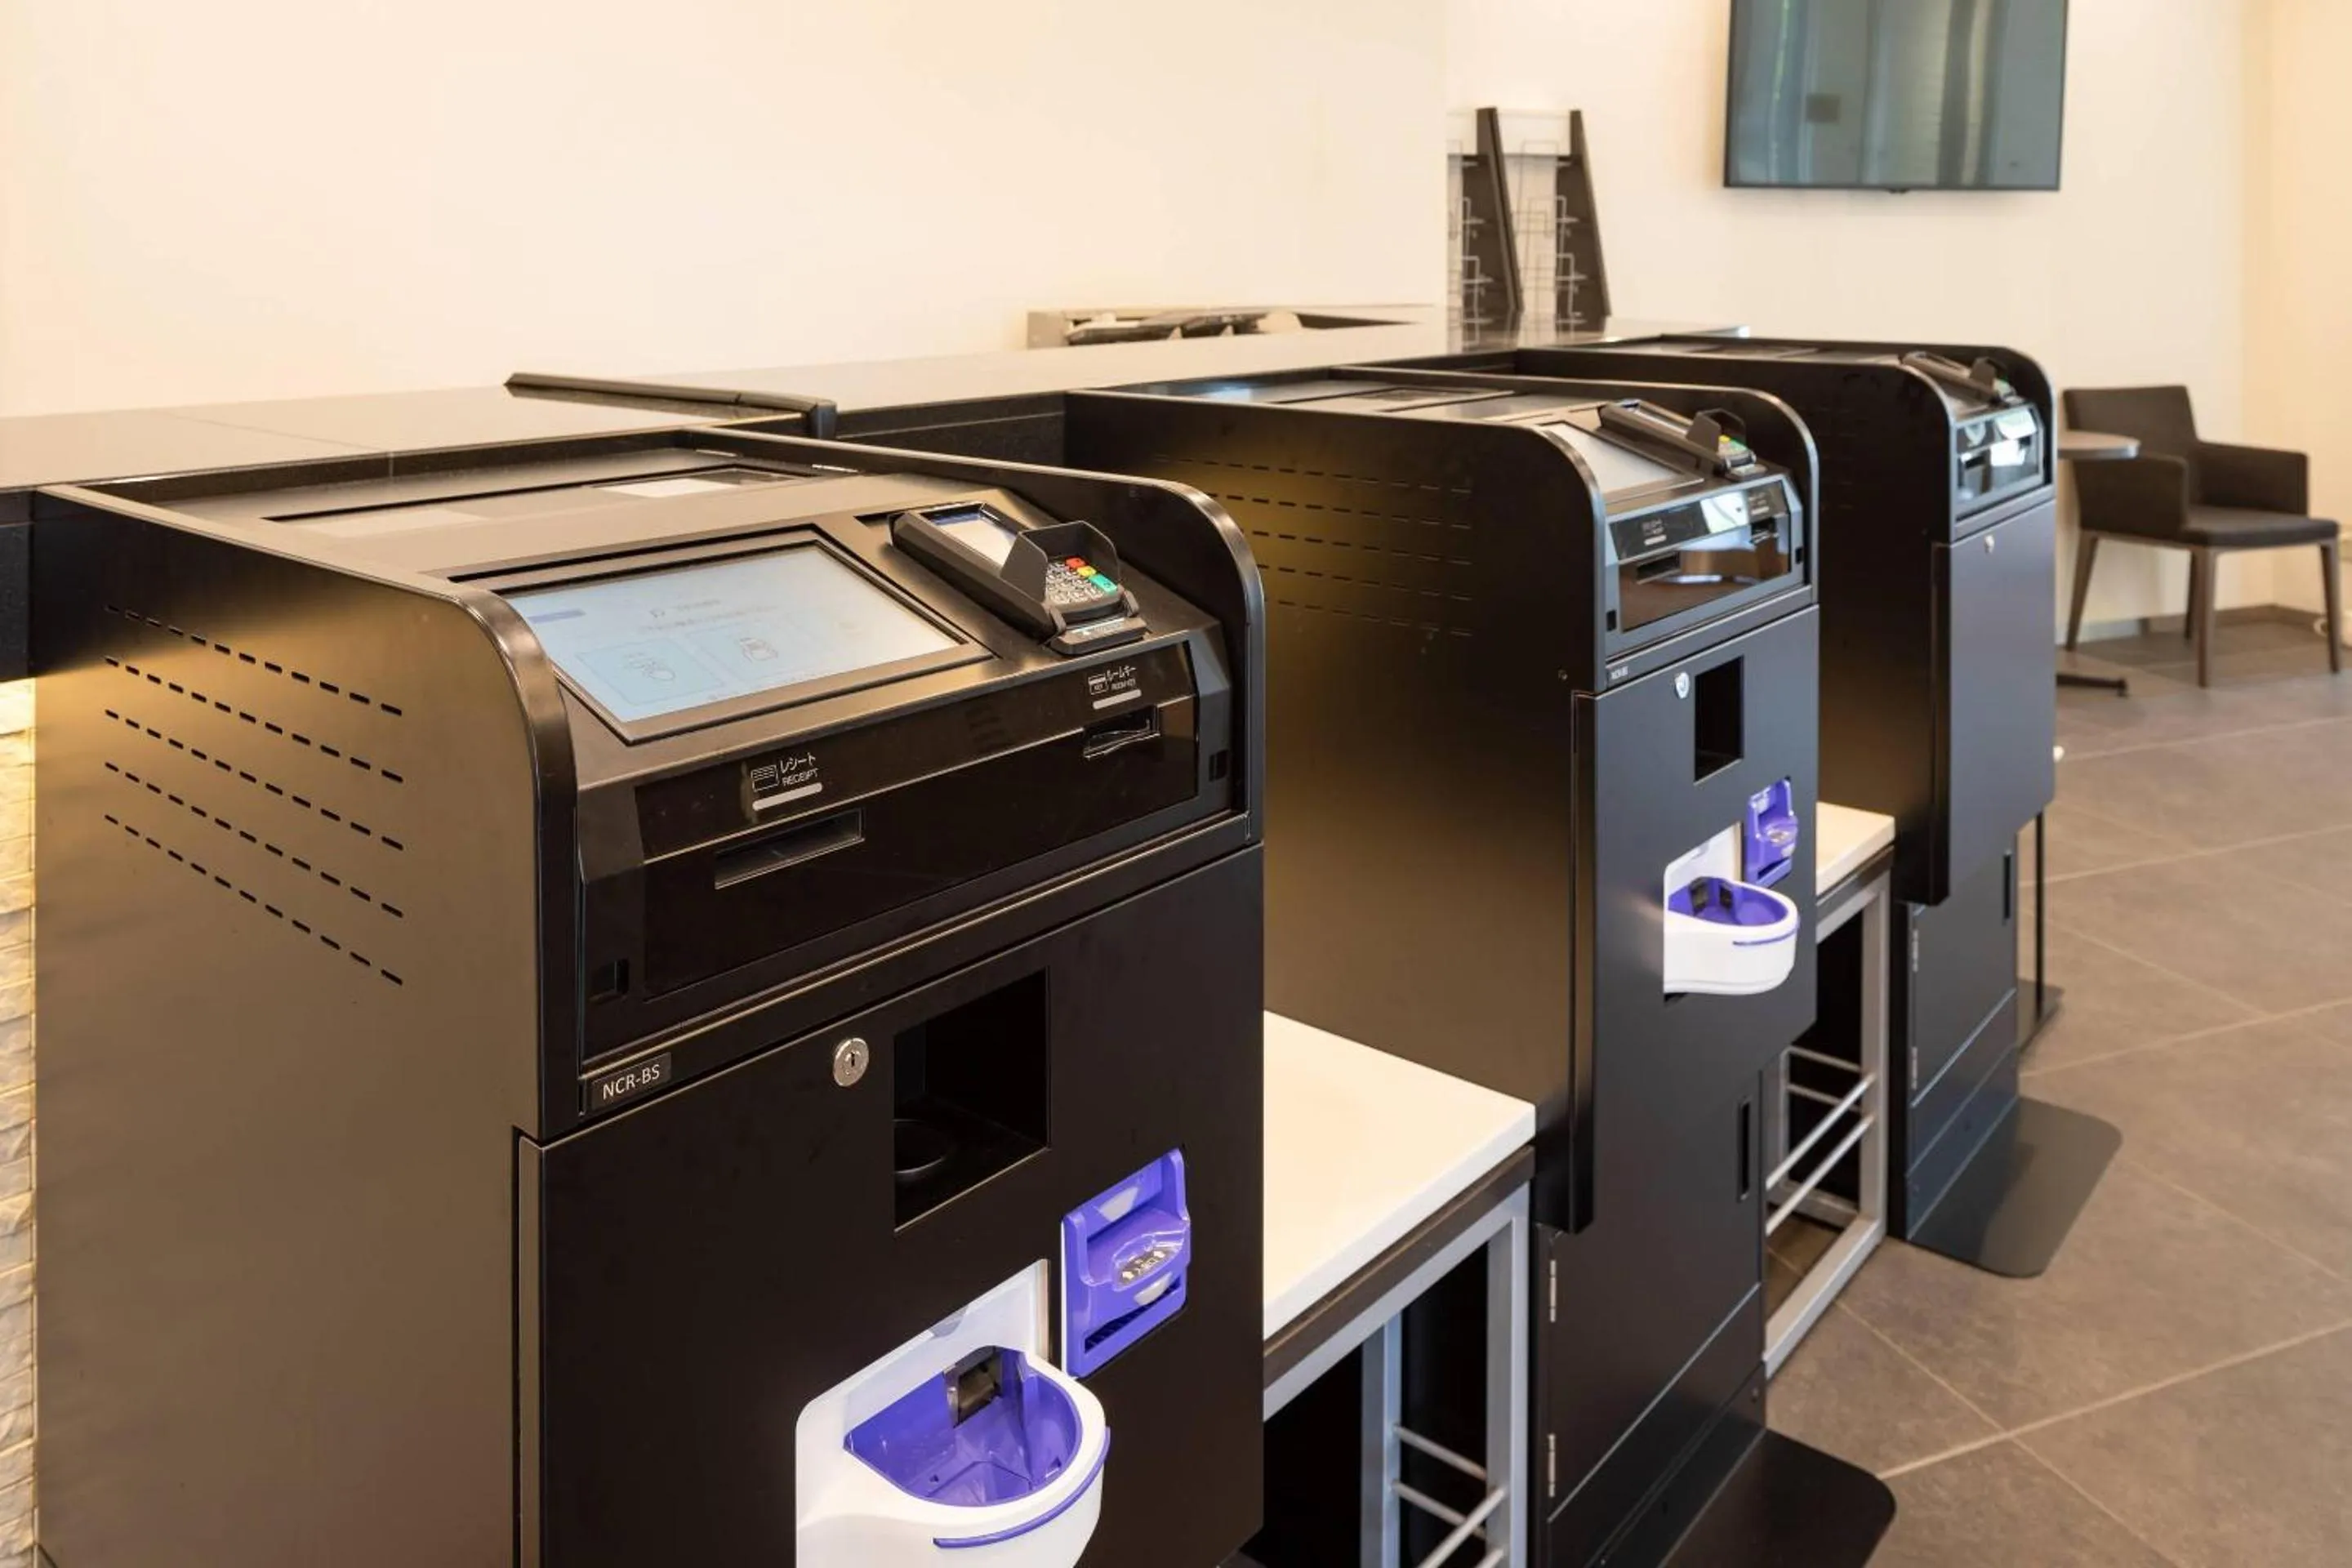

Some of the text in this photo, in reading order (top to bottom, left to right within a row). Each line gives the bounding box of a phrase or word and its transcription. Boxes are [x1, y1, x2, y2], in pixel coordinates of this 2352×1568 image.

[780, 751, 817, 773] レシート
[782, 768, 818, 786] RECEIPT
[603, 1064, 660, 1100] NCR-BS
